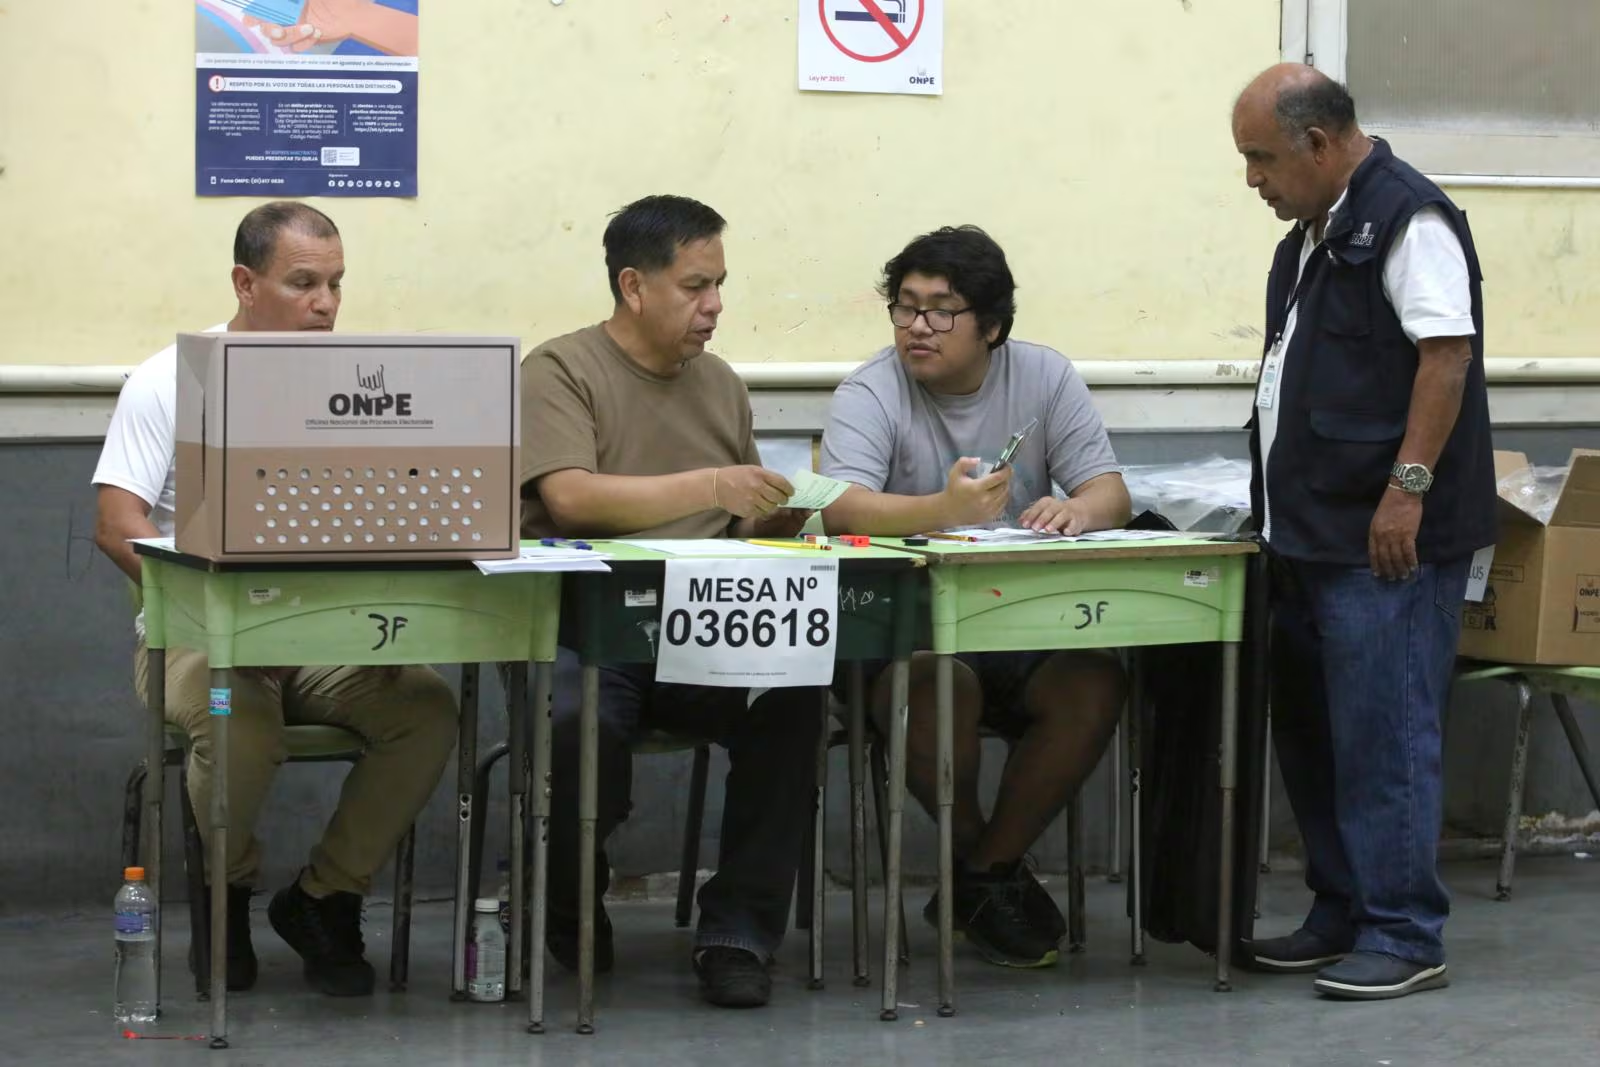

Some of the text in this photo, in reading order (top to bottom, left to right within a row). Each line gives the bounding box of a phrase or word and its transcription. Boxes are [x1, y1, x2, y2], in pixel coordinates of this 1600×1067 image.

[909, 76, 934, 84] ONPE
[328, 394, 412, 416] ONPE
[688, 578, 776, 602] MESA
[666, 608, 830, 648] 036618
[1074, 601, 1109, 630] 3F
[368, 614, 408, 650] 3F
